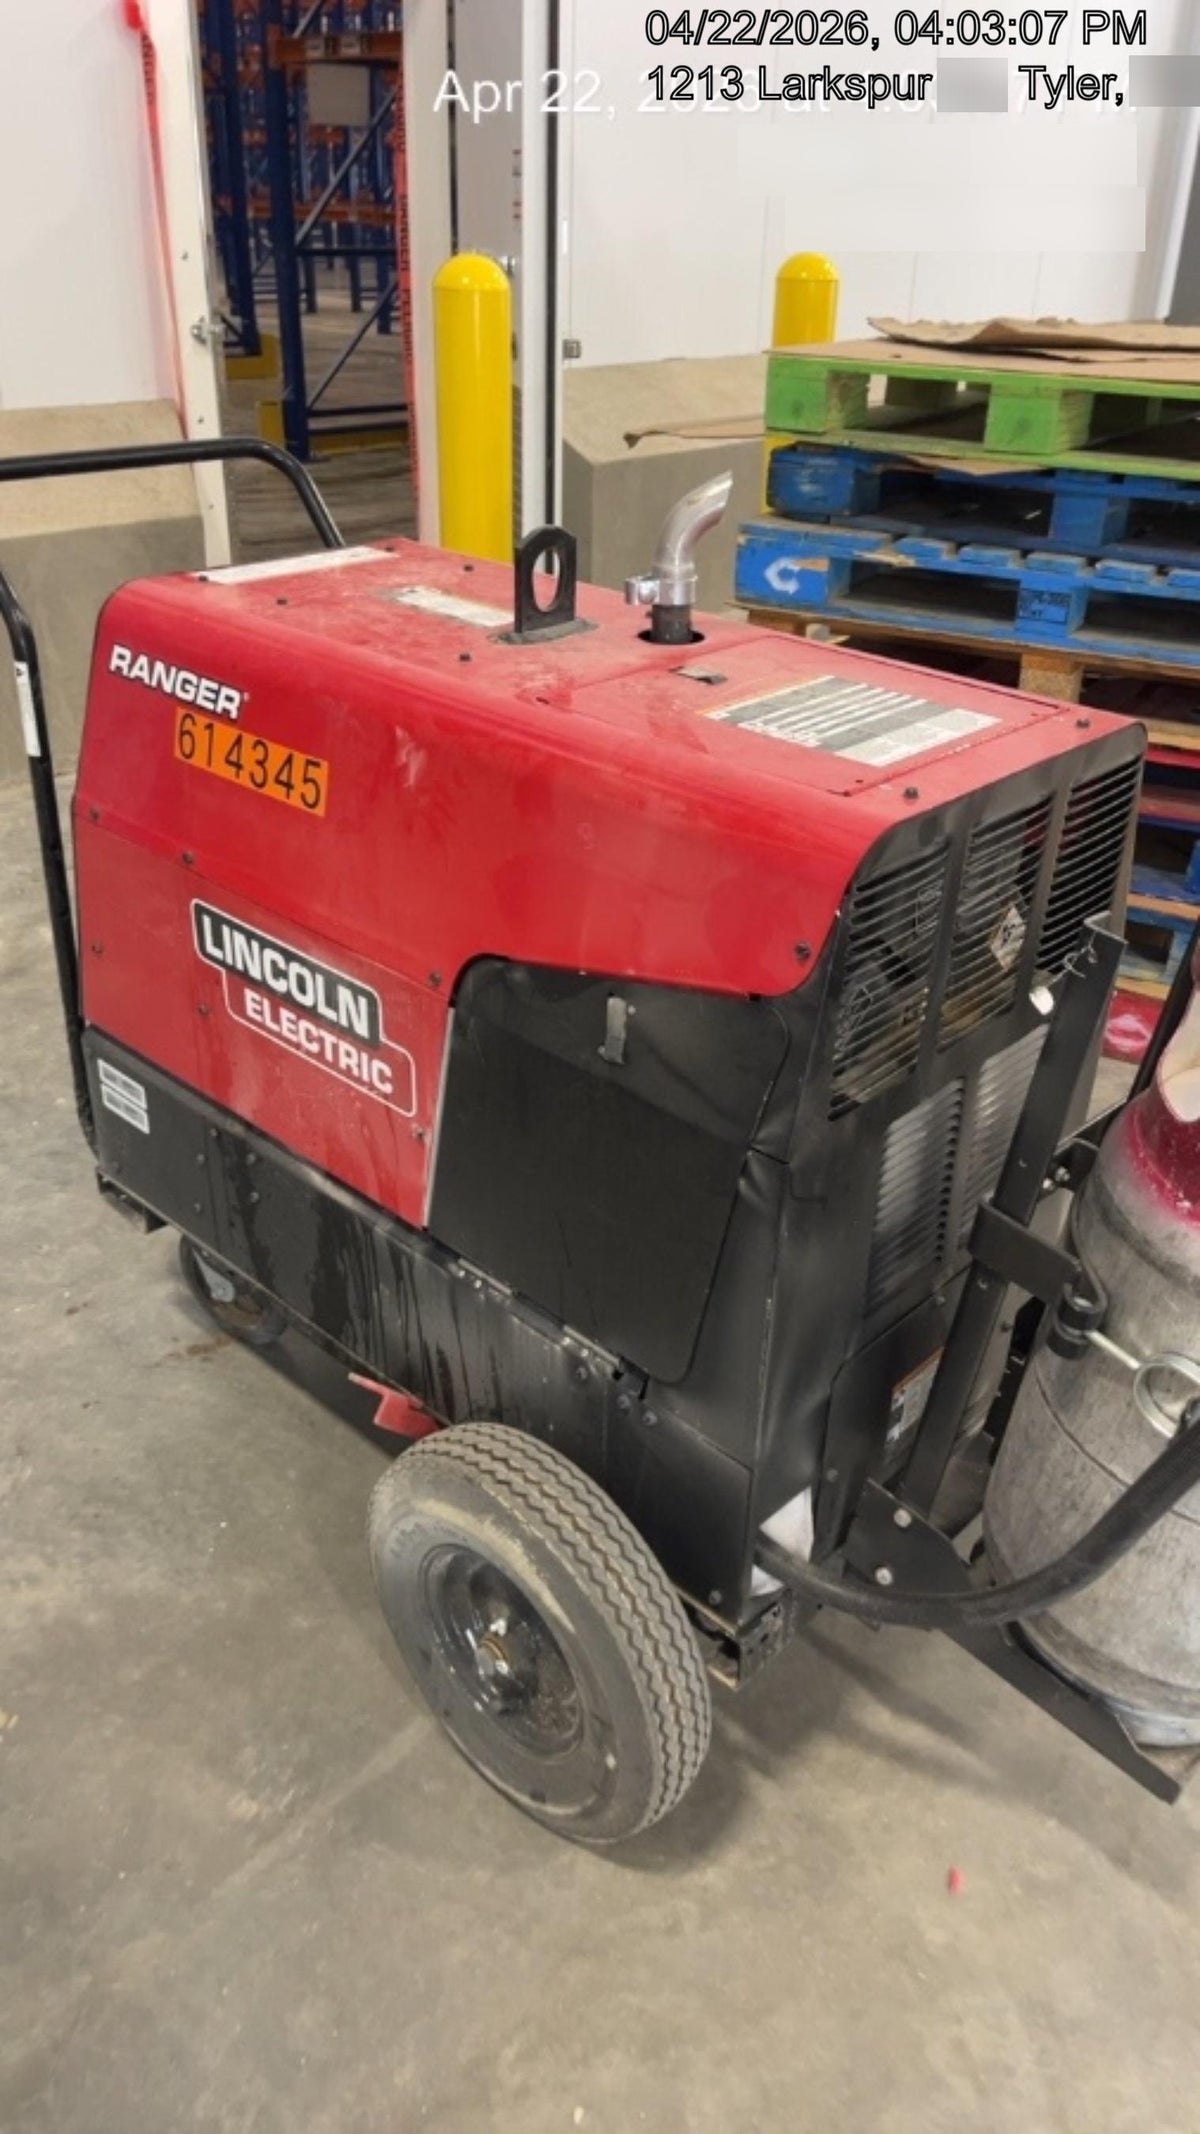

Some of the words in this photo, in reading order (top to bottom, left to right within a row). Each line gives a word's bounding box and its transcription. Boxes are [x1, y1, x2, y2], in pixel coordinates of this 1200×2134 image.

[109, 644, 241, 720] RANGER
[178, 712, 322, 810] 614345
[203, 914, 371, 1040] LINCOLN
[243, 987, 394, 1095] ELECTRIC
